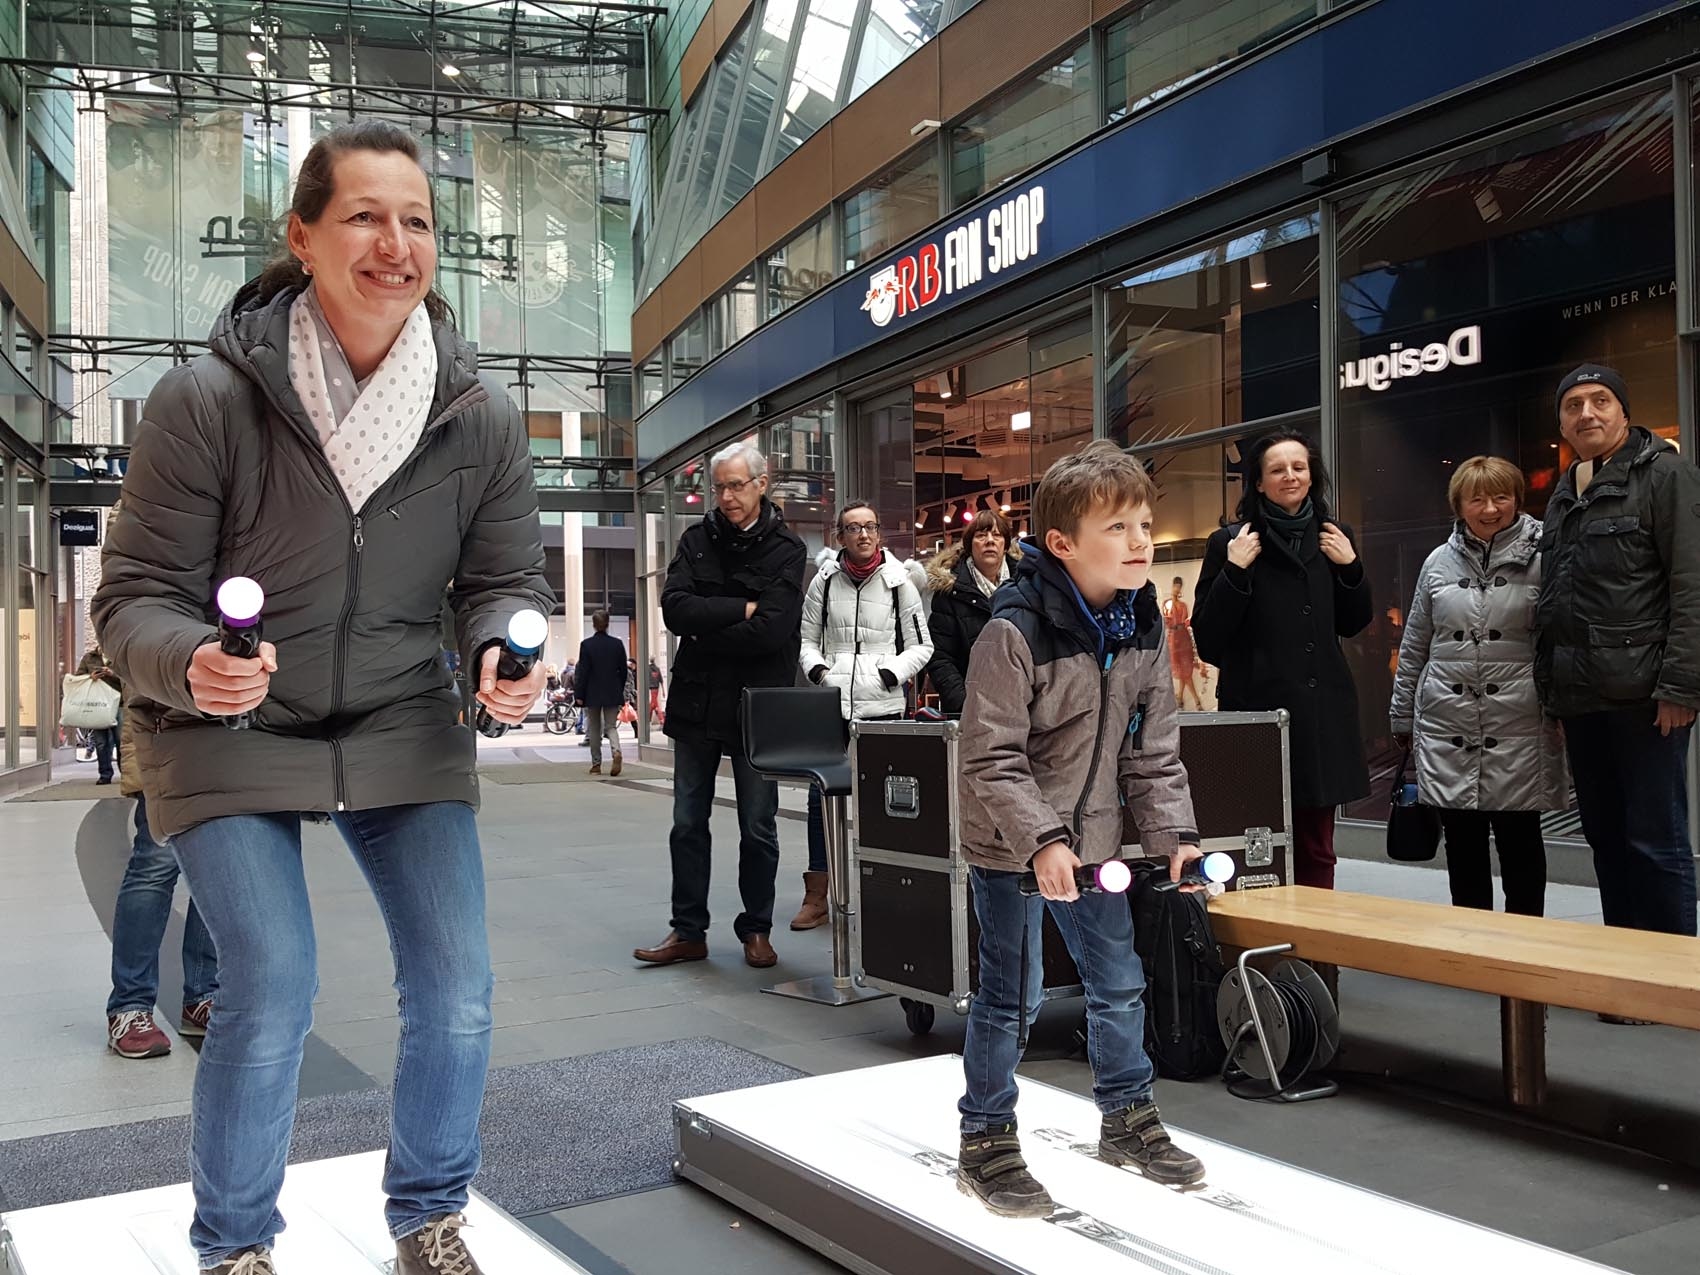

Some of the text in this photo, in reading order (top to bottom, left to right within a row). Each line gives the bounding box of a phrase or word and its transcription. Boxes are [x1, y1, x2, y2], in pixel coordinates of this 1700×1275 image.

[897, 243, 942, 317] RB
[945, 218, 982, 294] FAN
[987, 186, 1044, 273] SHOP
[1562, 299, 1602, 319] WENN
[1610, 290, 1639, 308] DER
